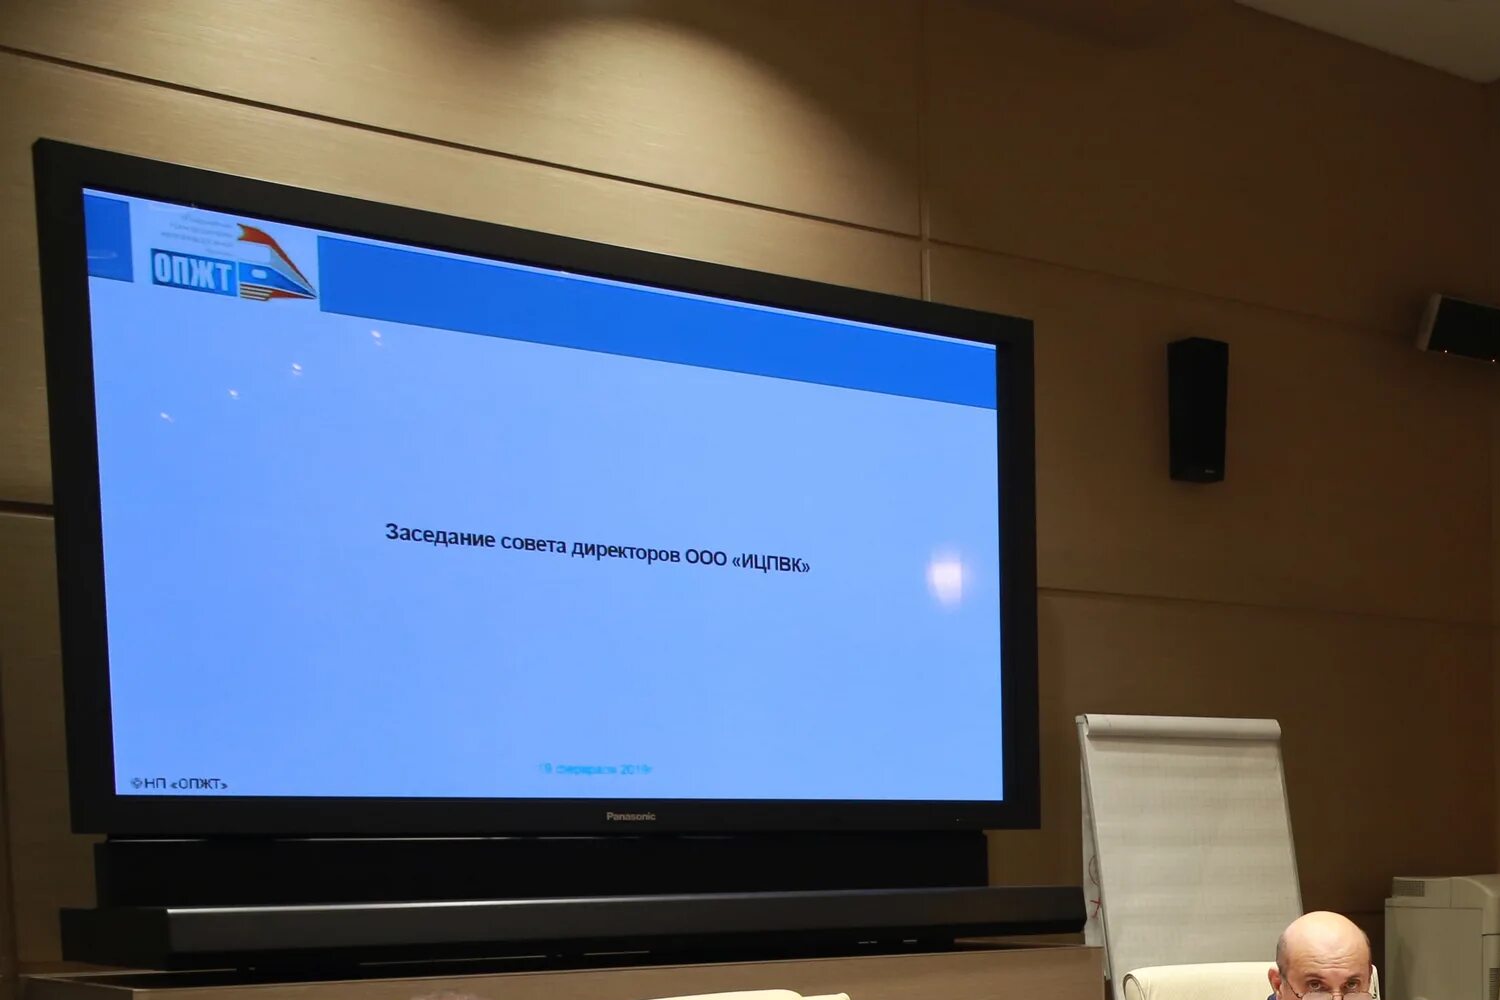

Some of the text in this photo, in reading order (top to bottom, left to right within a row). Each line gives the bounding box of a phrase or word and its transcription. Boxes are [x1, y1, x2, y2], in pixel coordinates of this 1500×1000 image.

[153, 252, 233, 292] ОПЖТ
[385, 522, 810, 574] Заседание совета директоров ООО «ИЦПВК»
[607, 812, 656, 821] Panasonic
